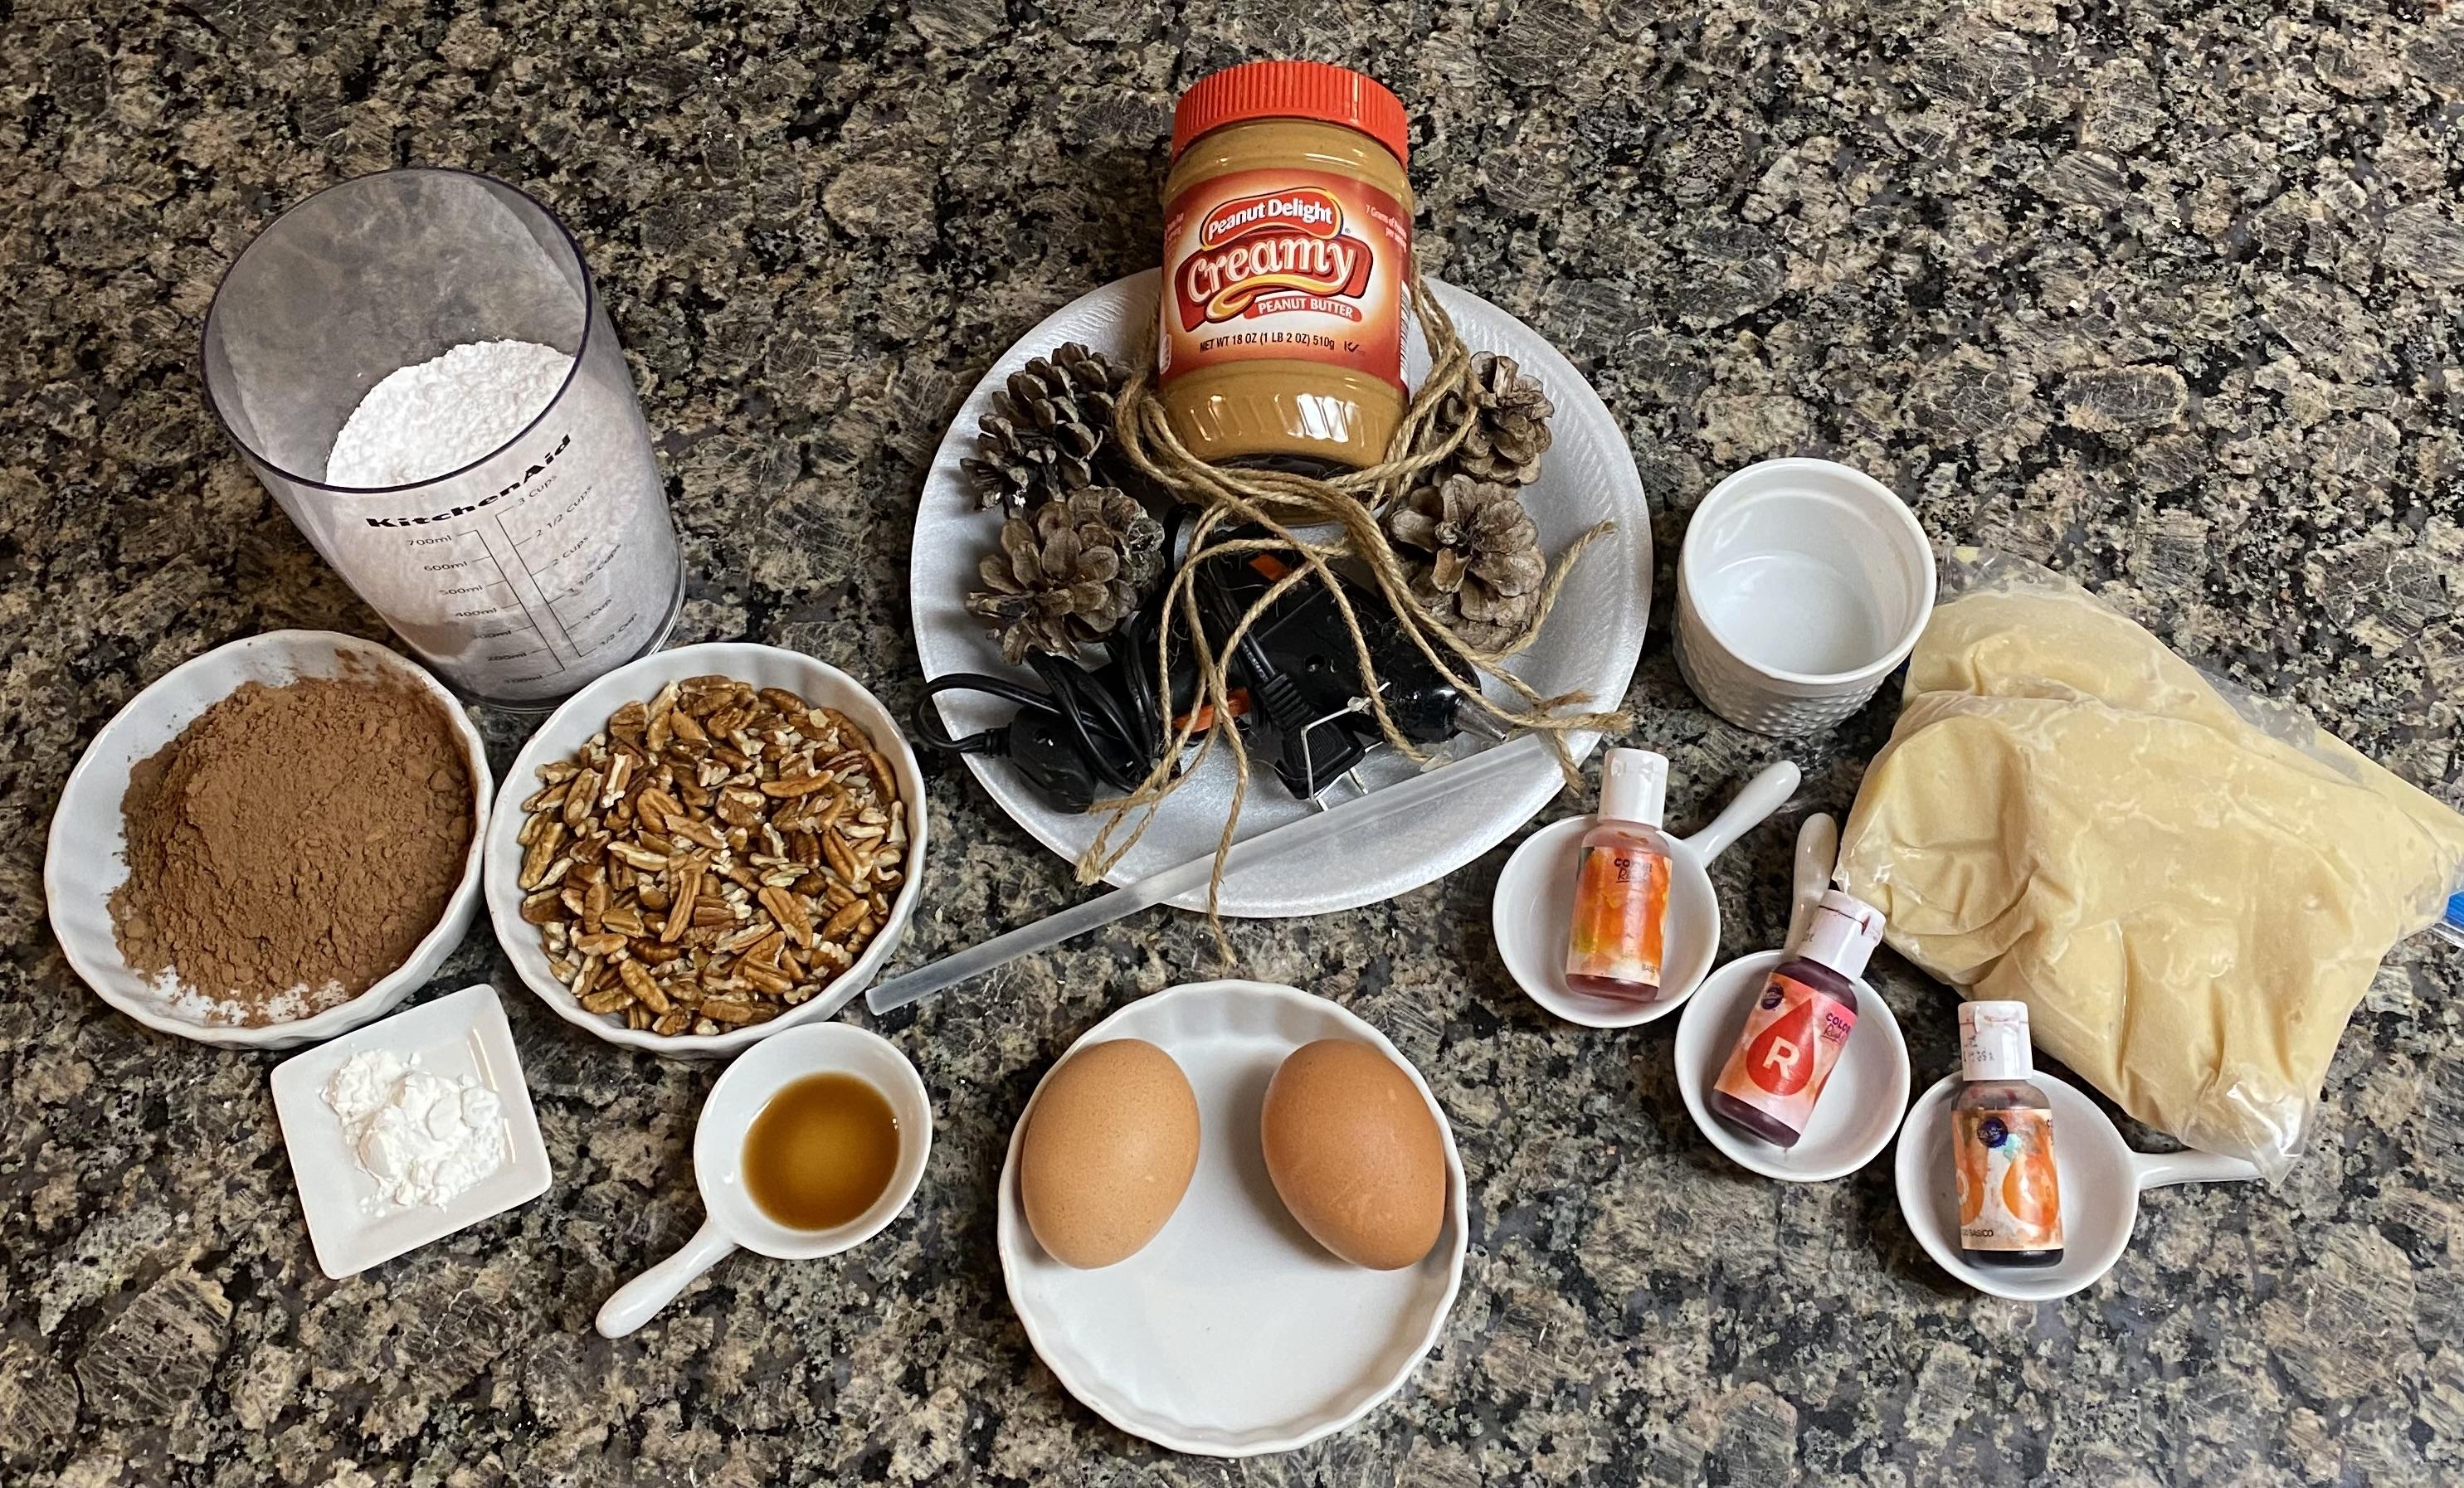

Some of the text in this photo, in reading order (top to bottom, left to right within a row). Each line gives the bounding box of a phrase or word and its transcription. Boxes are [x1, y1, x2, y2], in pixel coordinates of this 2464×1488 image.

[1208, 202, 1266, 241] Peanut
[1267, 197, 1333, 225] Delight
[1186, 237, 1355, 304] Creamy
[1259, 297, 1354, 319] PEANUT BUTTER
[1200, 332, 1336, 353] NET WT 18 OZ (1 LB 2 OZ) 510g
[365, 433, 572, 528] KitchenAid
[518, 498, 525, 506] 3
[535, 529, 543, 537] 2
[546, 513, 564, 528] 1/2
[406, 534, 452, 546] 700ml
[424, 561, 468, 571] 600ml
[438, 585, 484, 596] 500ml
[455, 607, 498, 617] 400ml
[474, 630, 512, 639] 00ml
[1762, 1036, 1800, 1079] R
